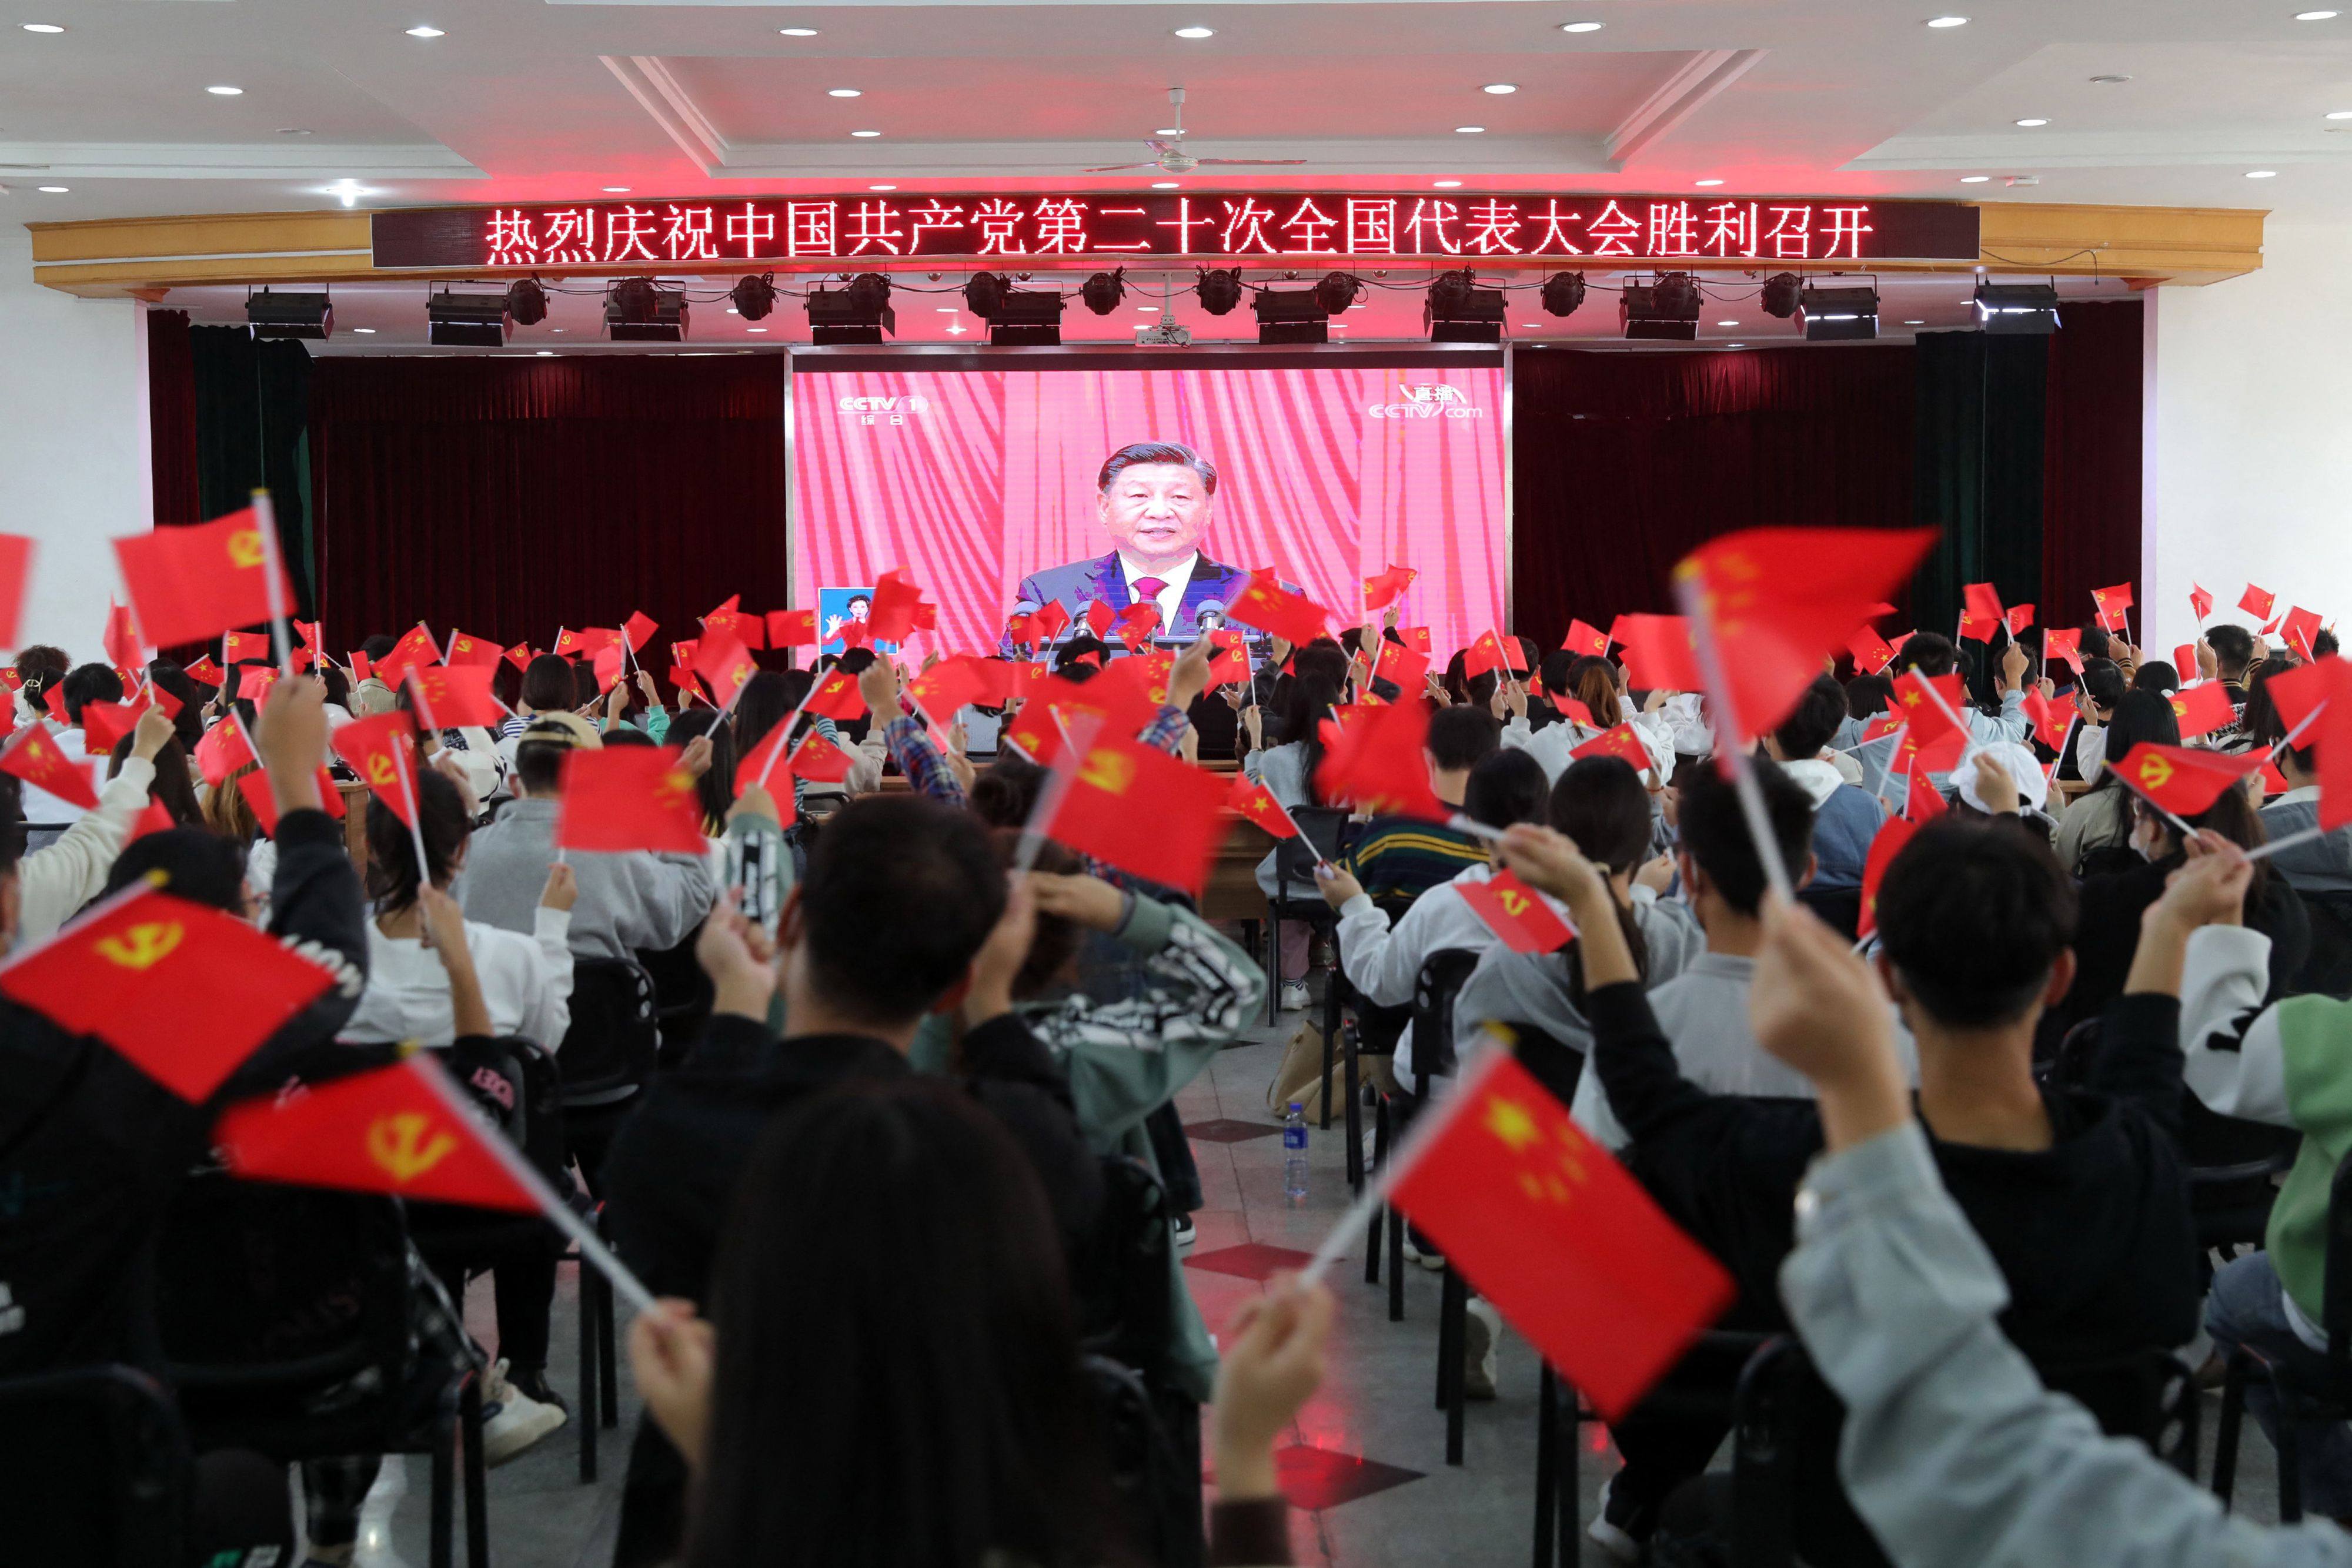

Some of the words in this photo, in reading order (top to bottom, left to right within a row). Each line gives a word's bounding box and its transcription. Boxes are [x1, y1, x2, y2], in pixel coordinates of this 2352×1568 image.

[486, 198, 1873, 265] 热烈庆祝中国共产党第二十次全国代表大会胜利召开
[1413, 386, 1454, 402] 直播
[839, 396, 897, 411] CCTV
[861, 414, 903, 426] 综合
